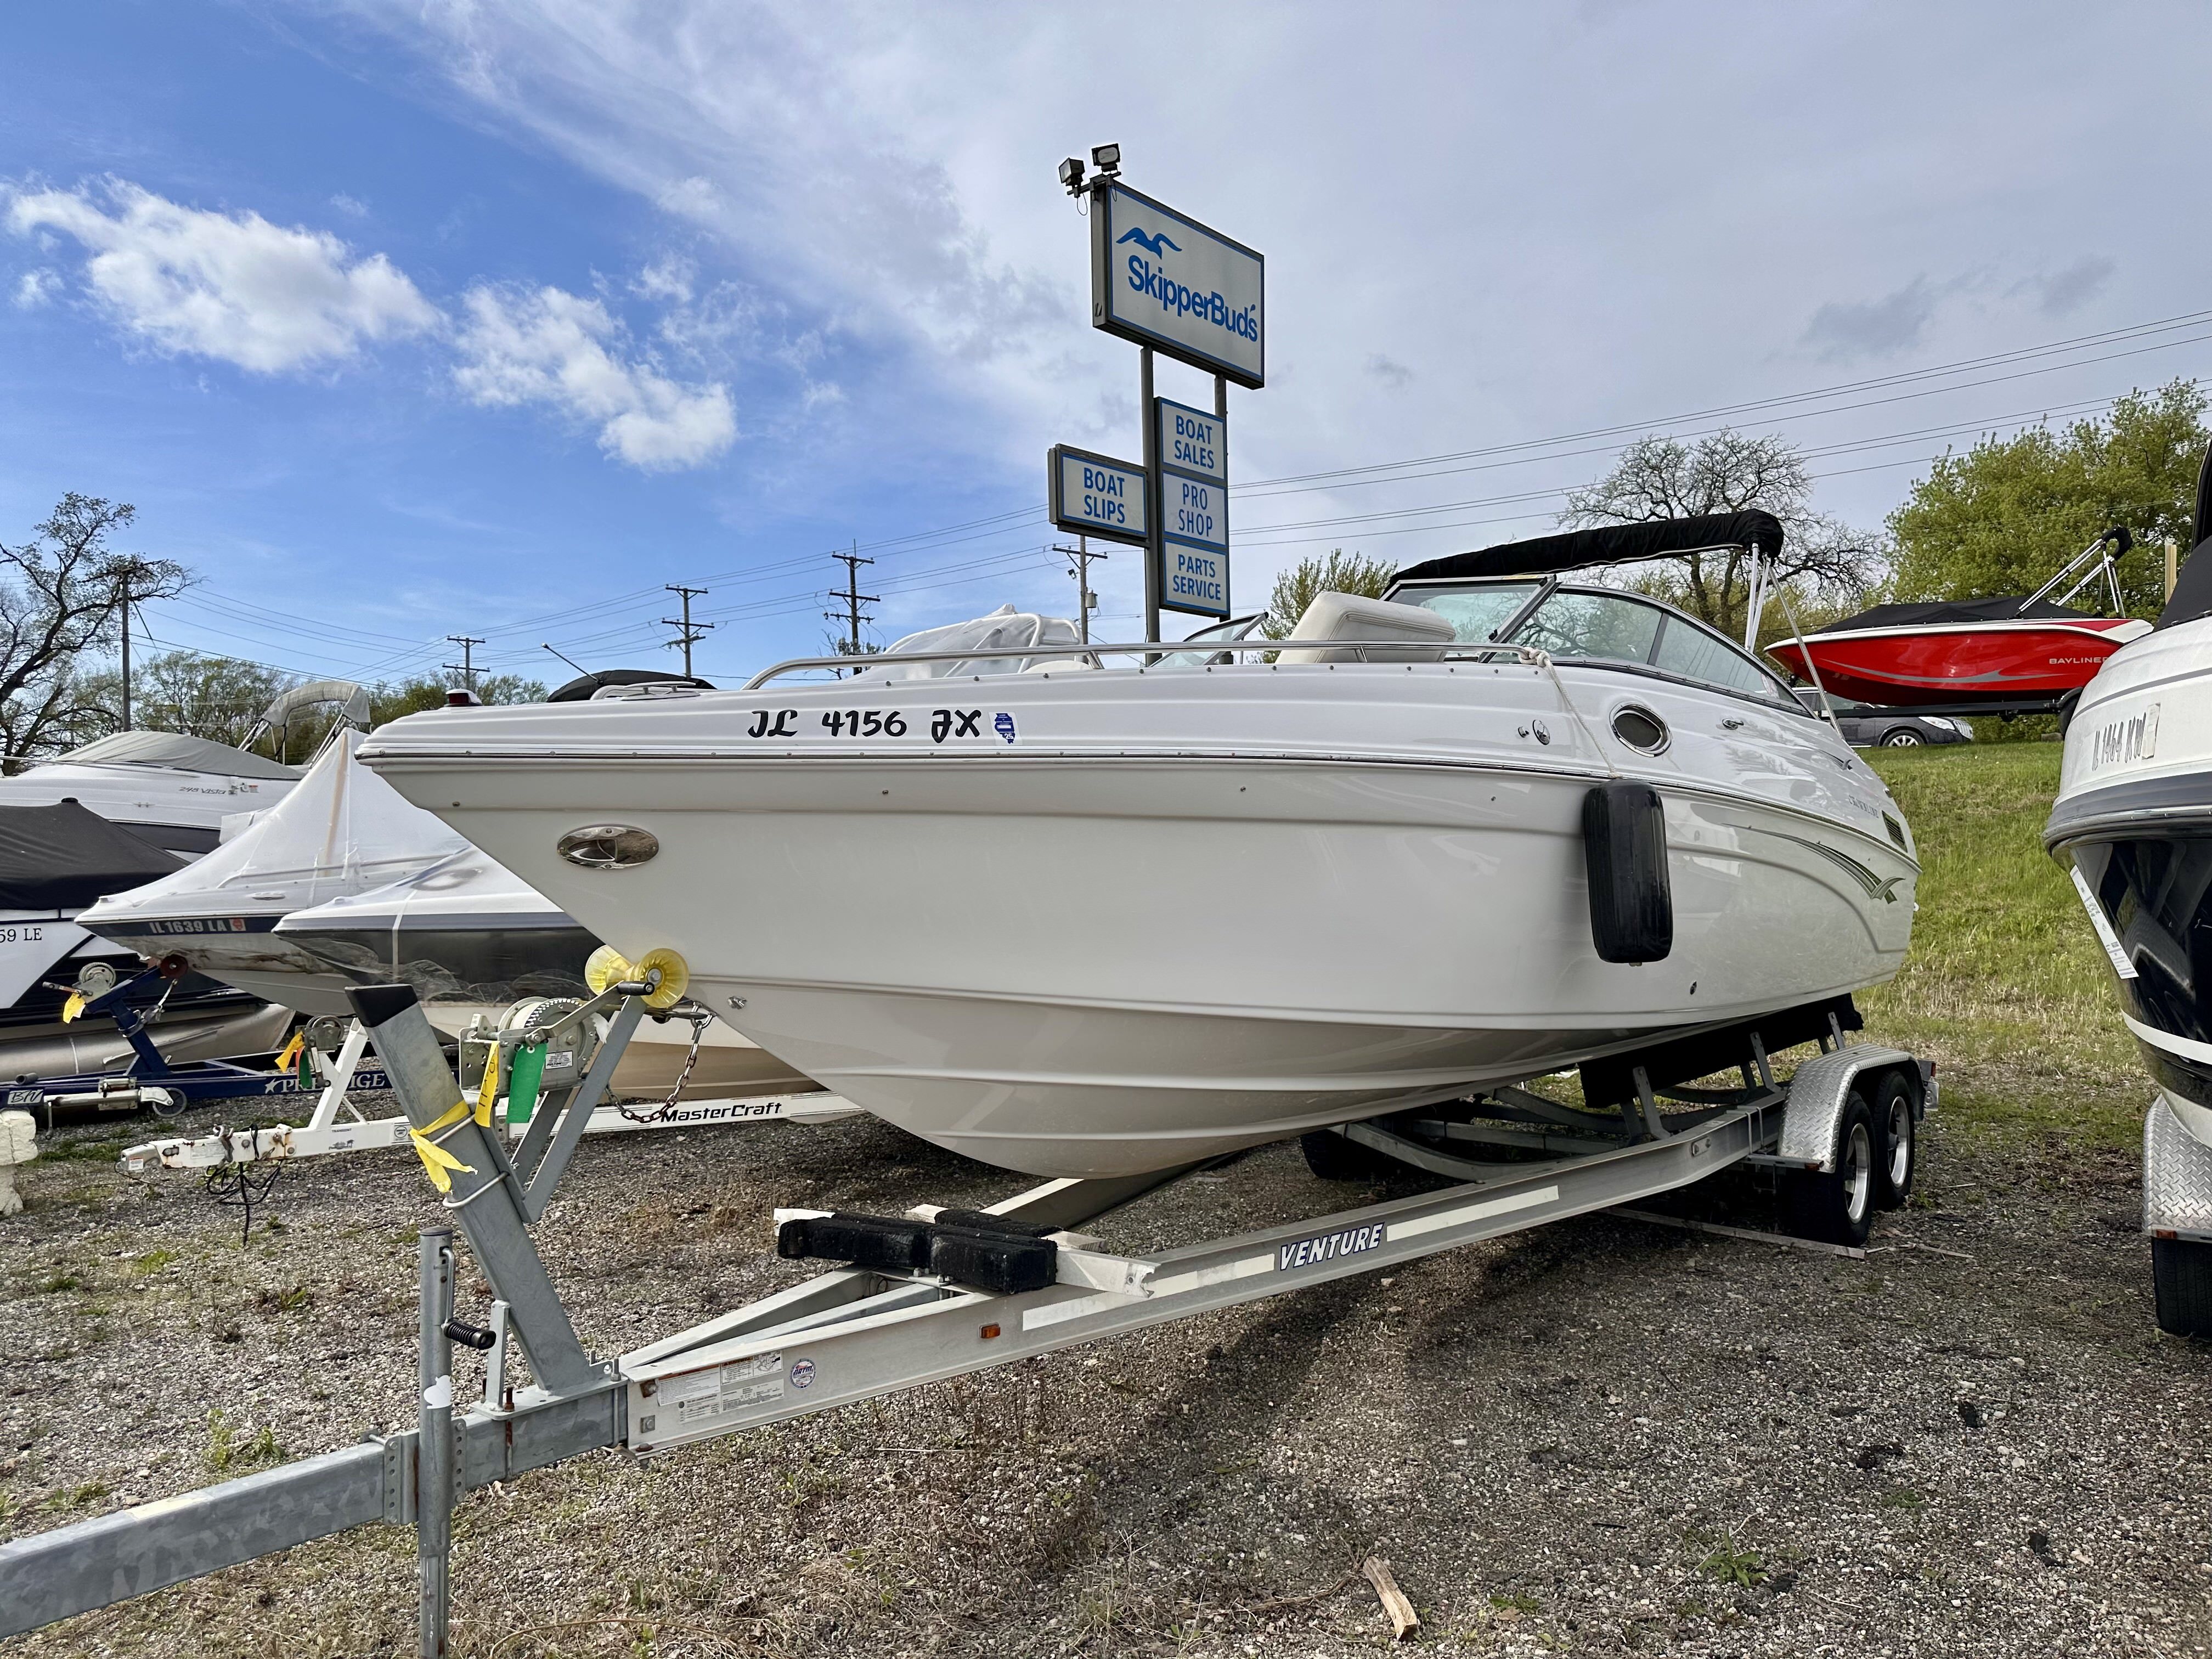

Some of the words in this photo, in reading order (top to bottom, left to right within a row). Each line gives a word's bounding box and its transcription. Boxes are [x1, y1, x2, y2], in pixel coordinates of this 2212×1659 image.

[1128, 255, 1258, 342] SkipperBud's
[1176, 415, 1212, 444] BOAT
[1174, 439, 1214, 470] SALES
[1084, 467, 1125, 498] BOAT
[1084, 495, 1125, 524] SLIPS
[1182, 483, 1207, 511] PRO
[1178, 509, 1212, 537] SHOP
[1178, 554, 1215, 578] PARTS
[1172, 574, 1221, 601] SERVICE
[822, 710, 907, 737] 4156
[2101, 721, 2124, 764] 1464
[24, 928, 42, 940] LE
[207, 919, 227, 932] LA
[661, 1102, 782, 1122] MasterCraft
[1280, 1222, 1385, 1271] VENTURE
